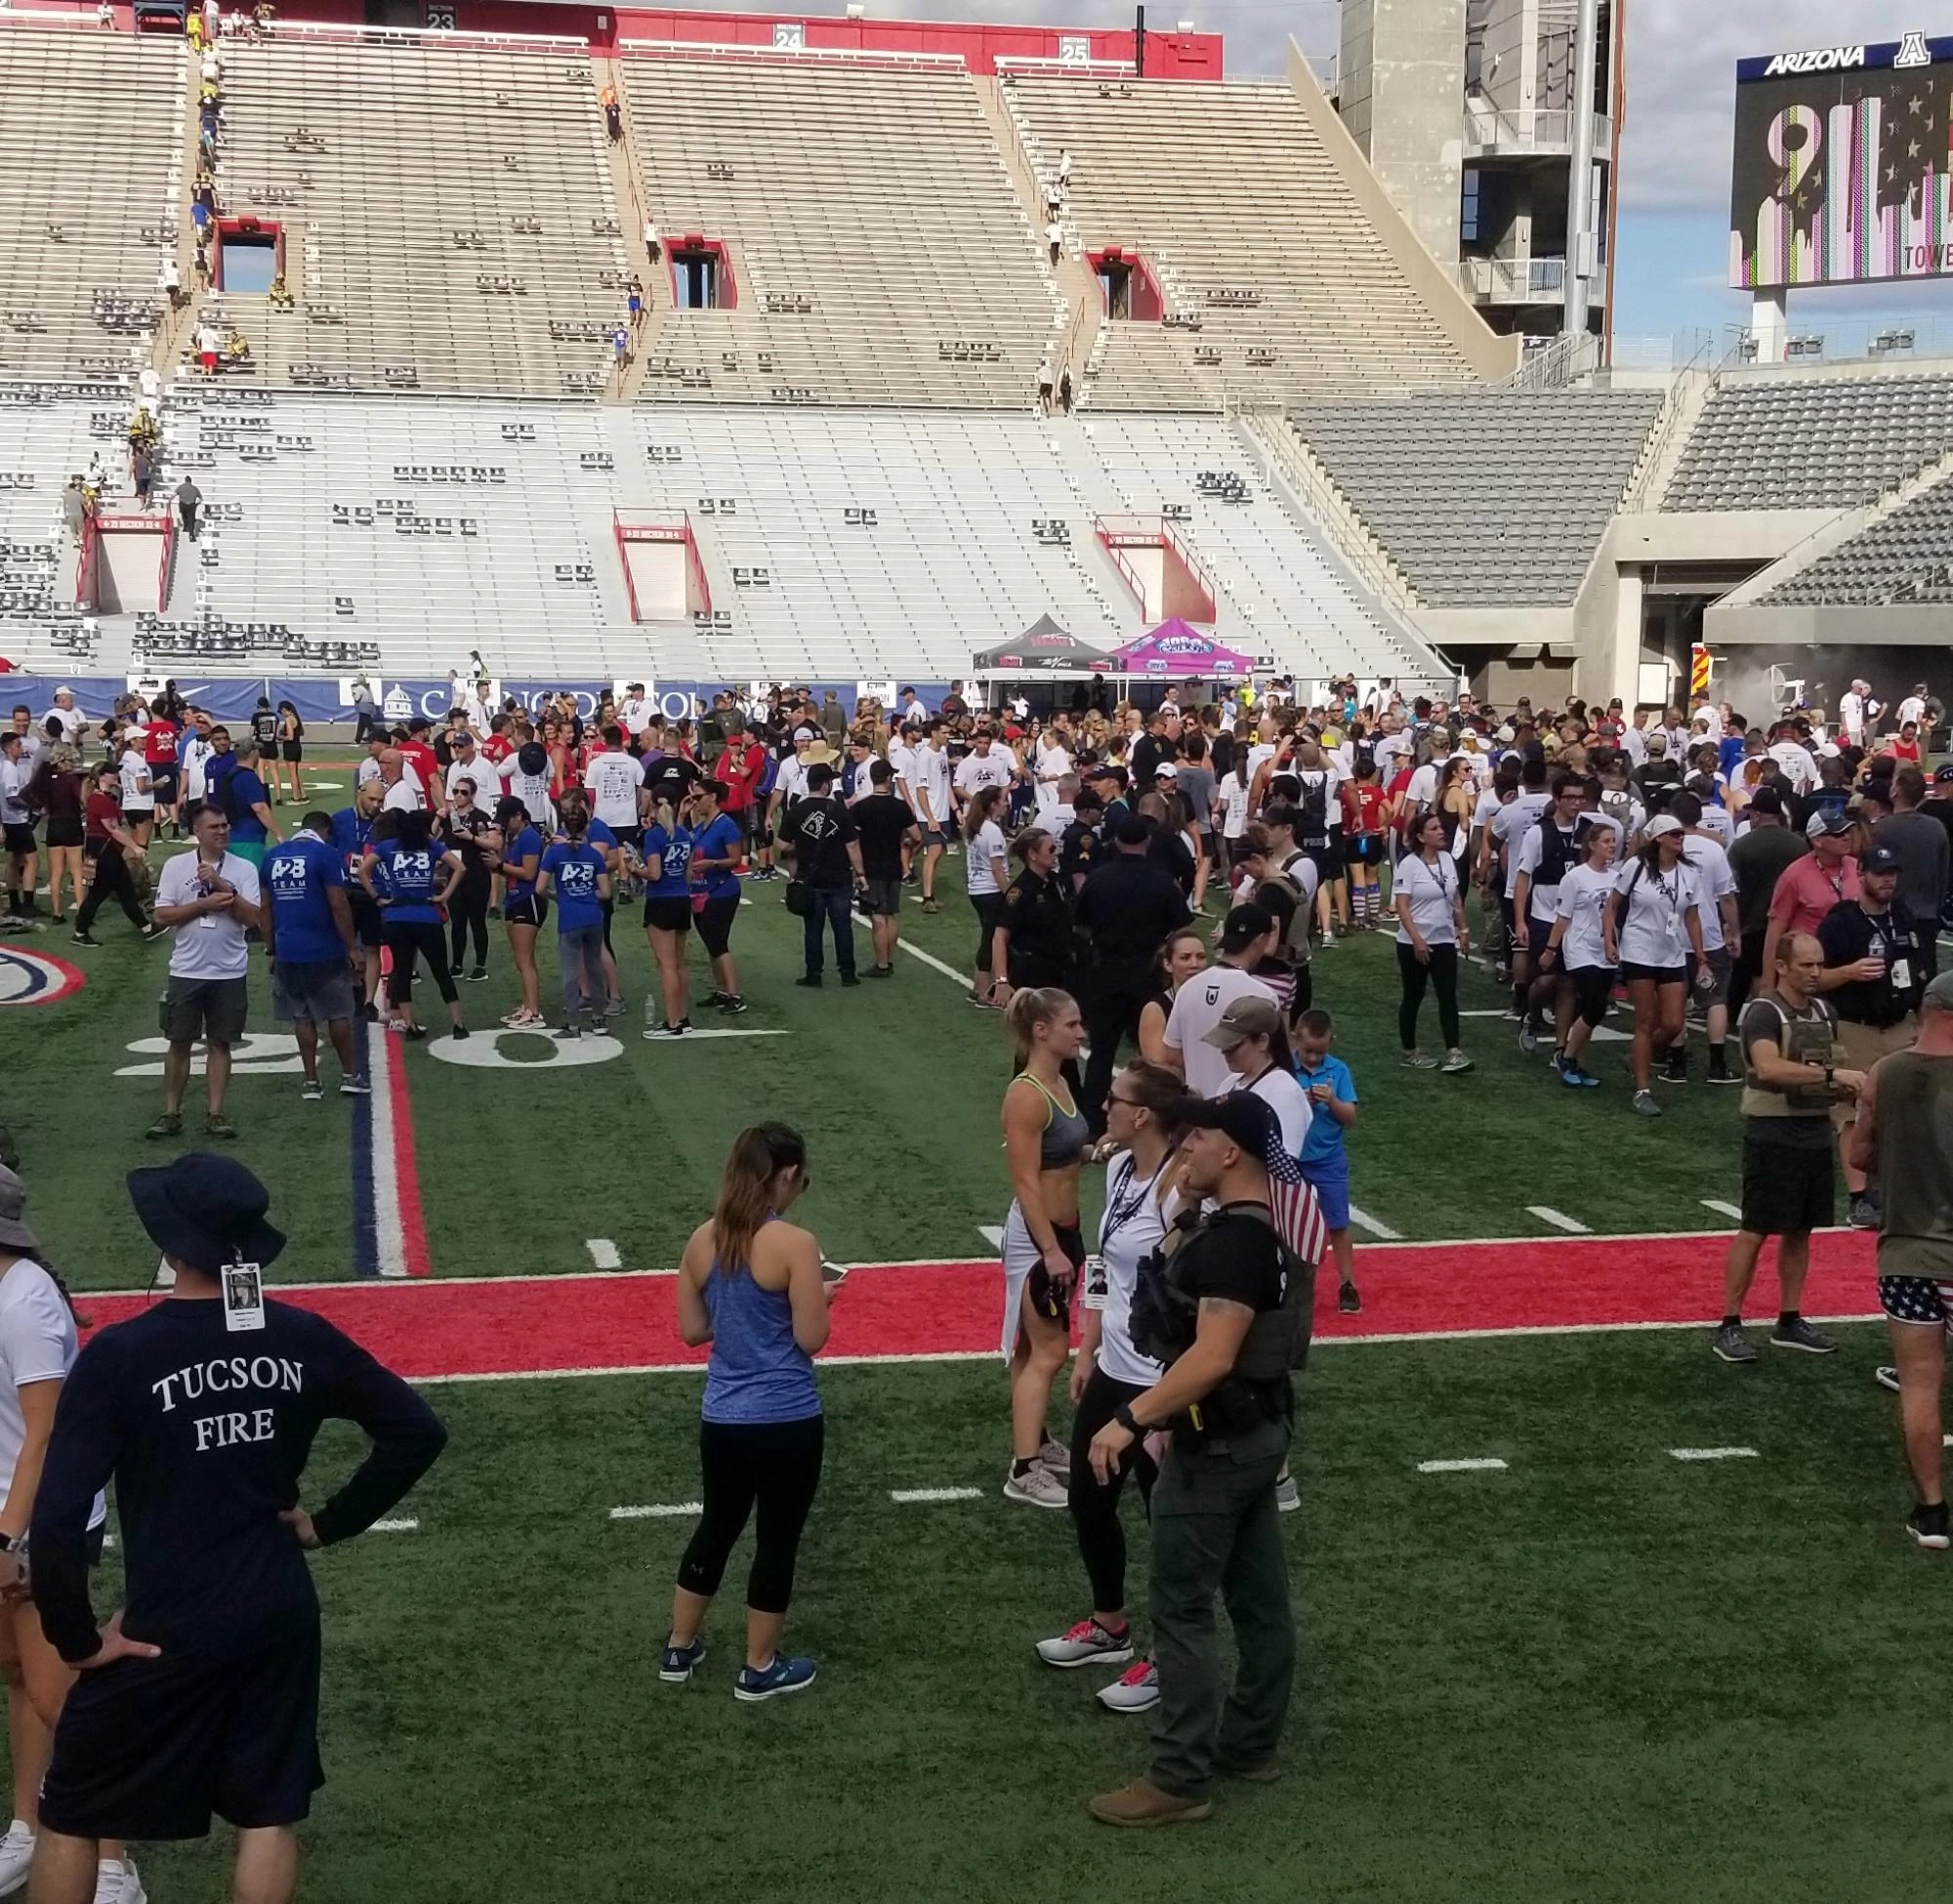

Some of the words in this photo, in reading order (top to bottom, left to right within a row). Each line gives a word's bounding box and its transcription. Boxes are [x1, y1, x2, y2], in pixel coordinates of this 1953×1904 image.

[427, 13, 455, 30] 23
[775, 31, 802, 48] 24
[1061, 44, 1088, 60] 25
[1764, 46, 1864, 76] ARIZONA
[1893, 29, 1932, 68] A
[270, 858, 306, 881] A2B
[151, 1356, 304, 1413] TUCSON
[193, 1408, 275, 1452] FIRE
